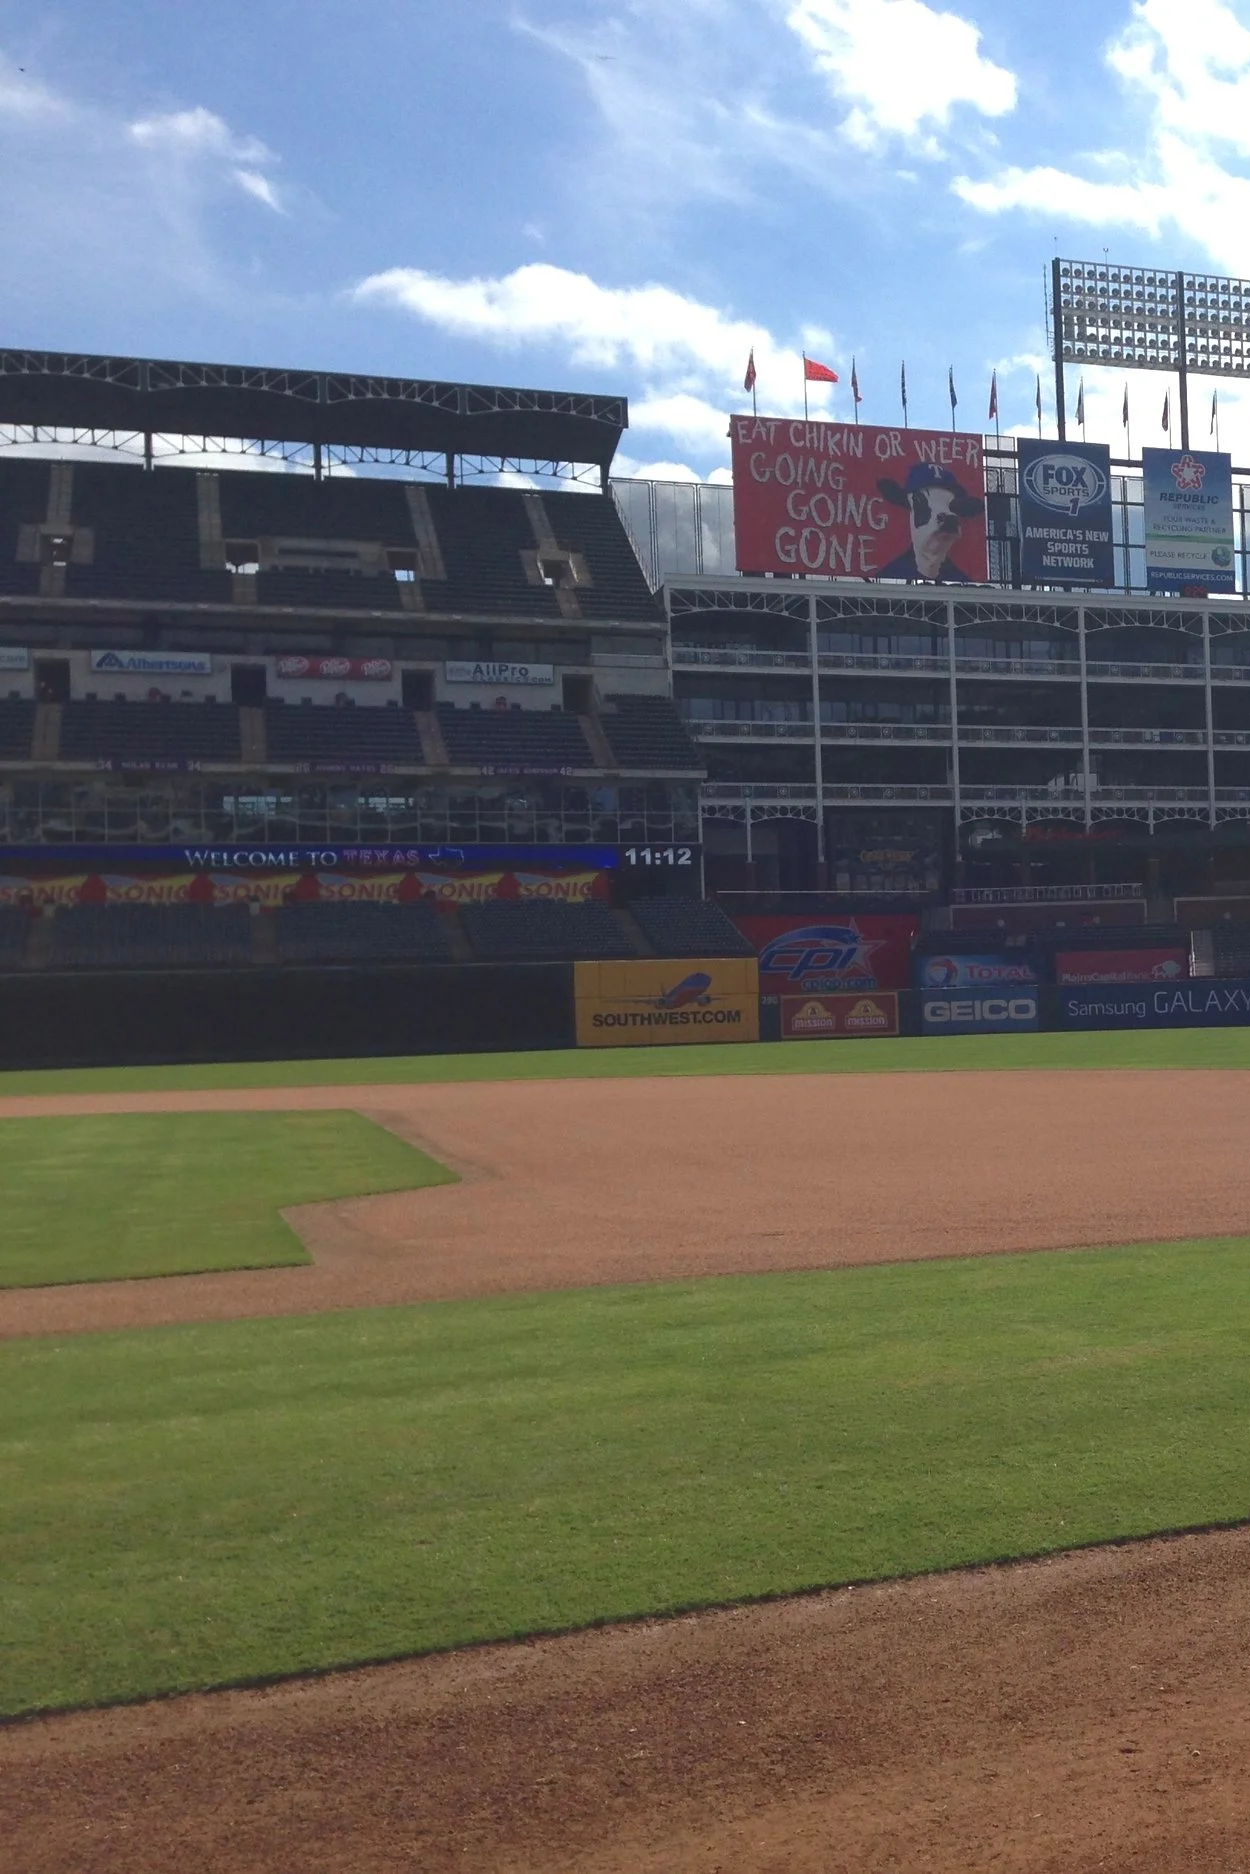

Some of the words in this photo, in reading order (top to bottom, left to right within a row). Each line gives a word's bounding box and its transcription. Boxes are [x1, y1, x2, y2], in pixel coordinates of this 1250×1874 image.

[737, 420, 783, 447] EAT
[789, 420, 863, 459] CHIKIN
[875, 431, 906, 462] OR
[913, 437, 981, 468] WEER
[750, 451, 848, 491] GOING
[1042, 464, 1088, 489] FOX
[1043, 486, 1090, 498] SPORTS
[1159, 492, 1219, 504] REPUBLIC
[786, 489, 889, 530] GOING
[1069, 497, 1080, 516] 1
[1025, 526, 1083, 541] AMERICA'S
[1085, 530, 1109, 542] NEW
[1152, 523, 1193, 532] RECYCLING
[1195, 525, 1226, 534] PARTNER
[775, 526, 877, 573] GONE
[1047, 541, 1089, 555] SPORTS
[1150, 550, 1175, 559] PLEASE
[1042, 555, 1094, 569] NETWORK
[1150, 571, 1233, 582] REPUBLICSERVICES.COM
[126, 657, 206, 671] Albertsons
[473, 664, 529, 676] AllPro
[482, 766, 495, 776] 42
[560, 766, 573, 776] 42
[184, 849, 299, 867] WELCOME
[306, 851, 337, 867] TO
[343, 849, 420, 866] TEXAS
[624, 847, 692, 865] 11:12
[107, 885, 190, 901] SONIC
[320, 883, 400, 899] SONIC
[520, 881, 593, 898] SONIC
[924, 998, 1036, 1022] GEICO
[1068, 1000, 1146, 1018] Samsung
[592, 1010, 741, 1028] SOUTHWEST.COM
